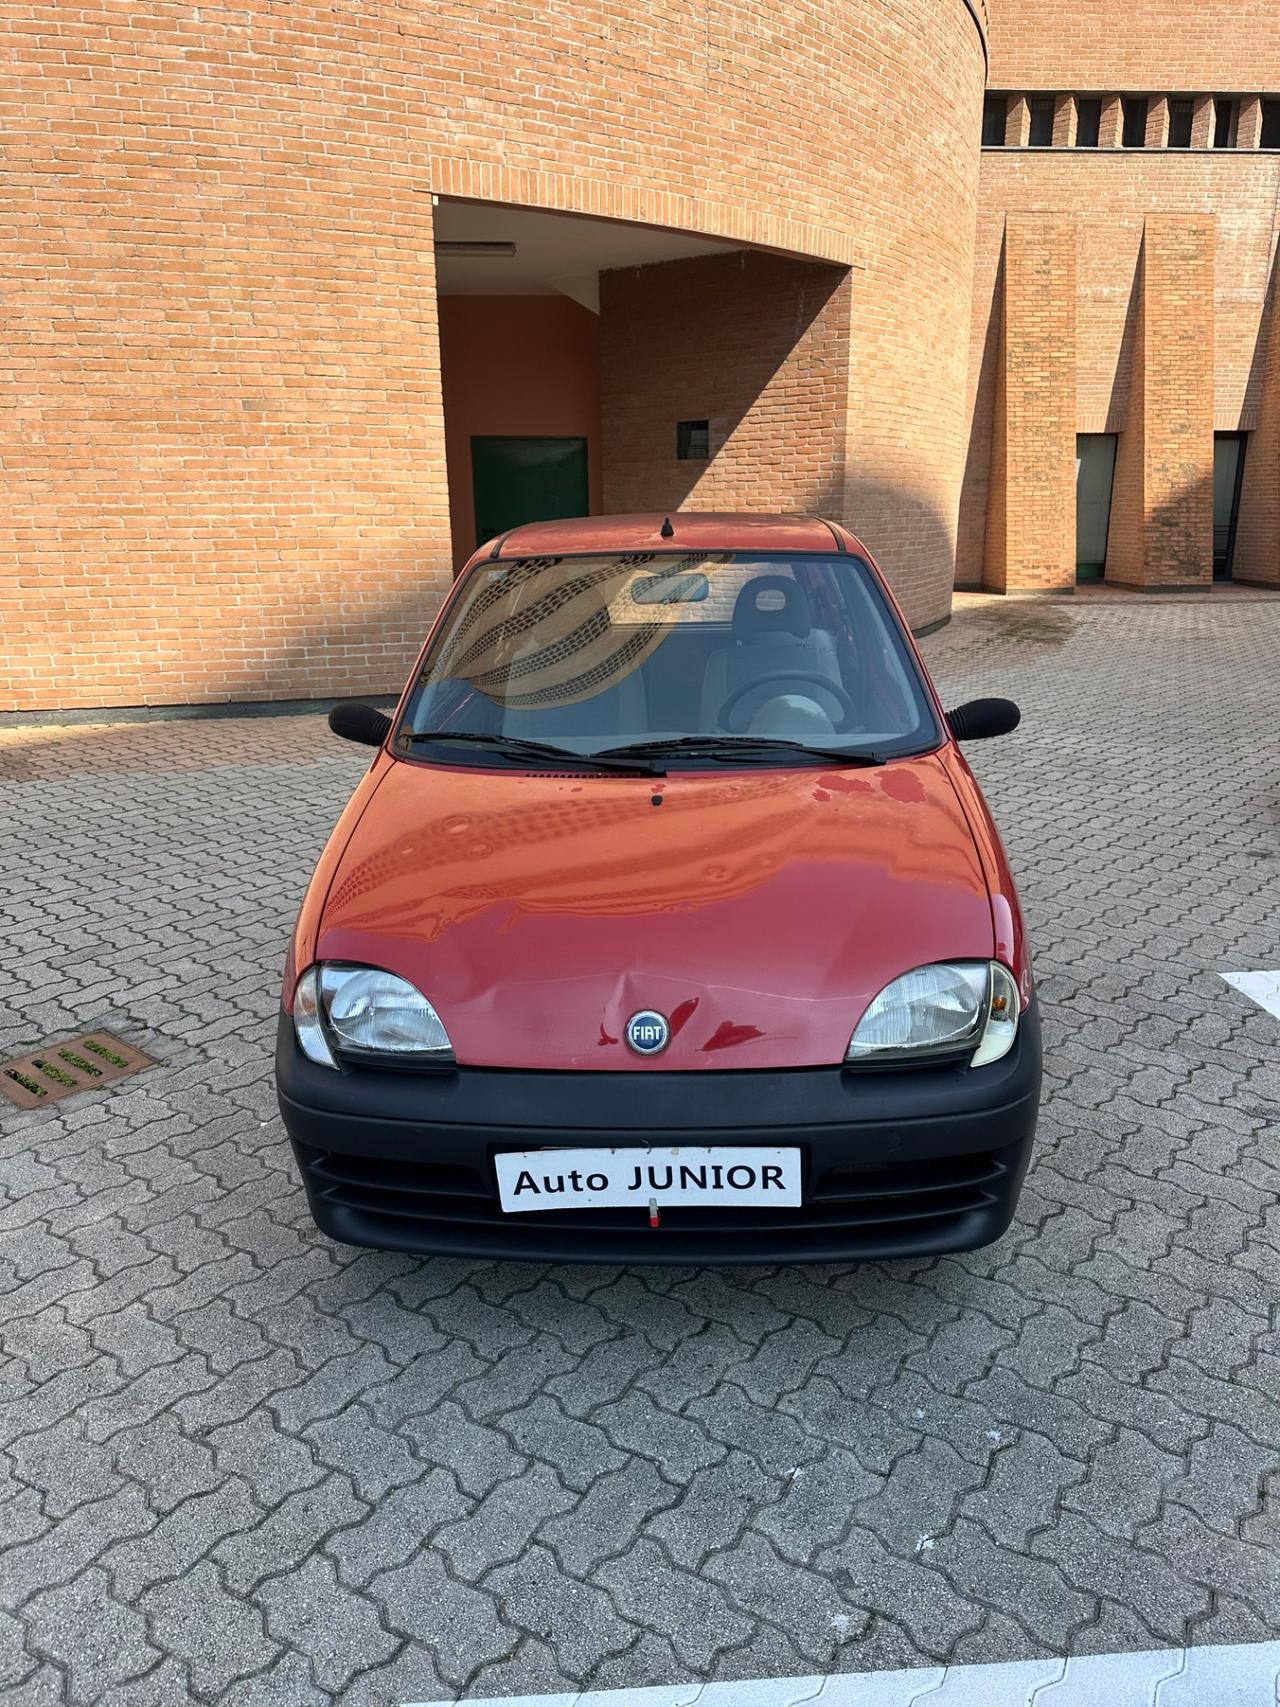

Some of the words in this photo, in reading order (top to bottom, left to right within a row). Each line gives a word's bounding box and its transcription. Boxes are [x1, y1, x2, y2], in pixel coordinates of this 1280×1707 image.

[633, 1026, 661, 1040] FIAT
[513, 1170, 609, 1195] Auto
[628, 1165, 786, 1190] JUNIOR
